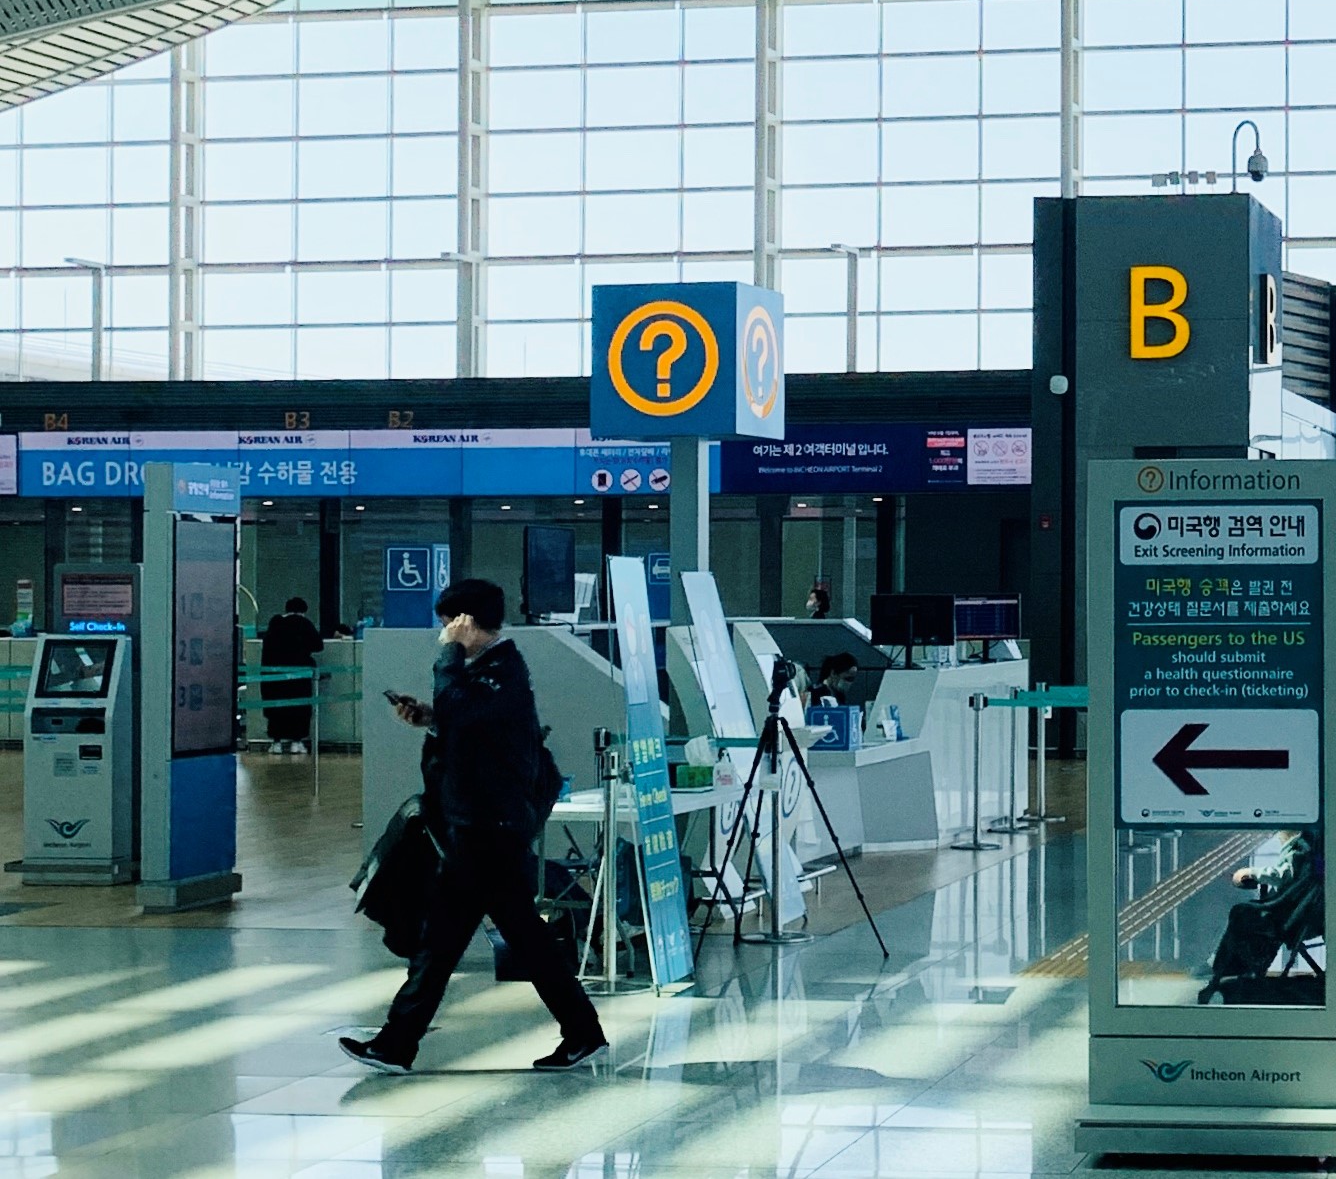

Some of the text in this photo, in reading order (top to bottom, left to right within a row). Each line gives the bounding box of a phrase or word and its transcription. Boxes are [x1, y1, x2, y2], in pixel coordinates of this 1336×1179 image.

[1130, 265, 1190, 359] B
[44, 413, 69, 431] B4
[285, 411, 311, 429] B3
[388, 410, 414, 429] B2
[67, 436, 131, 446] KOREAN AIR
[238, 435, 303, 445] KOREAN AIR
[413, 434, 479, 444] KOREAN AIR
[753, 445, 782, 456] 여기는
[804, 443, 856, 456] 여객터미널
[857, 443, 889, 456] 입니다.
[42, 462, 95, 486] BAG
[105, 462, 145, 486] DR
[257, 460, 315, 486] 수하물
[320, 460, 358, 486] 전용
[851, 465, 878, 473] Terminal
[878, 465, 883, 473] 2
[1169, 470, 1301, 491] Information
[1167, 515, 1306, 538] 미국행 검역 안내
[1134, 543, 1306, 560] Exit Screening Information
[1146, 578, 1293, 597] 미국행 승객은 발권 전
[1128, 600, 1311, 618] 건강상태 질문서를 제출하세요
[69, 621, 86, 632] Self
[1133, 631, 1306, 650] Passengers to the US
[1171, 650, 1266, 663] should submit
[1144, 667, 1294, 683] a health questionnaire
[1130, 684, 1309, 699] prior to check-in (ticketing)
[1190, 1066, 1302, 1086] Incheon Airport
